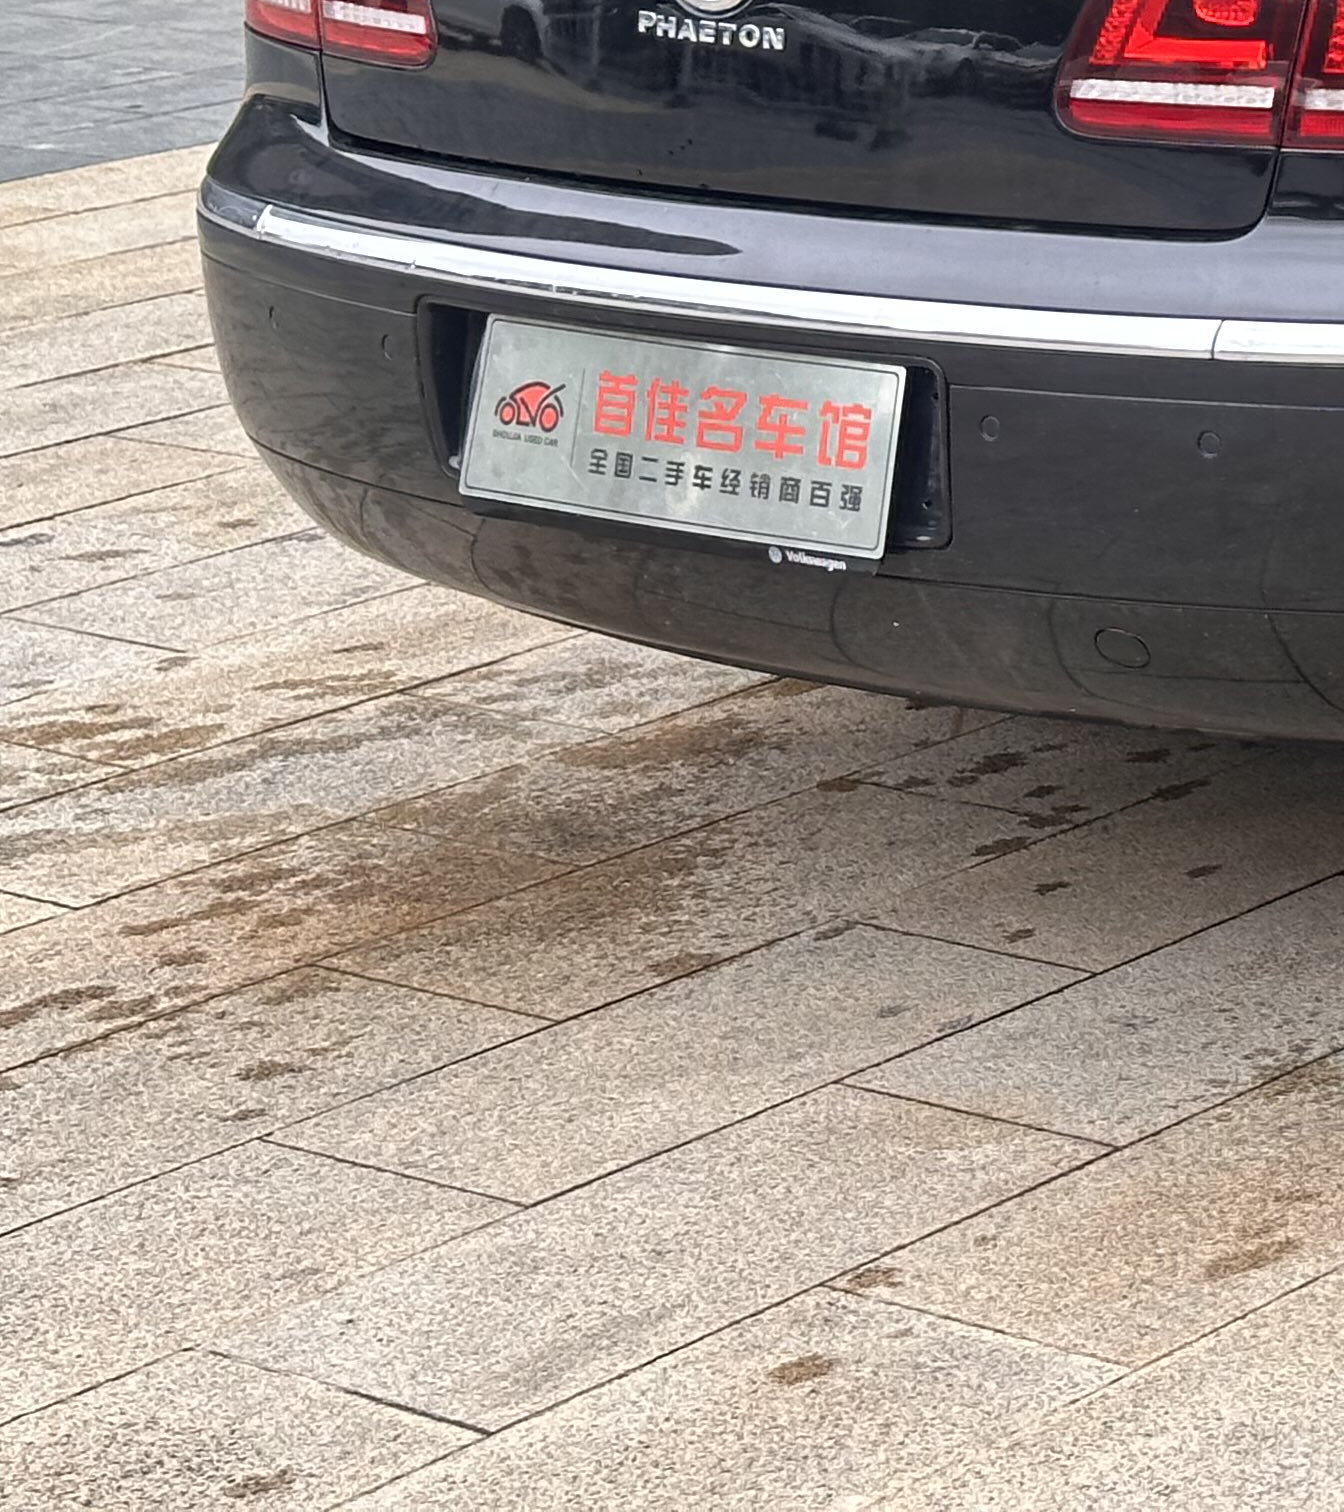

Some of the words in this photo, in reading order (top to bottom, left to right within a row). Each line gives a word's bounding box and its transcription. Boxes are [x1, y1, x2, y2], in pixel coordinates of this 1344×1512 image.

[637, 9, 785, 50] PHAETON
[594, 371, 871, 469] 首佳名车馆
[588, 449, 863, 512] 全国二手车经销商百强
